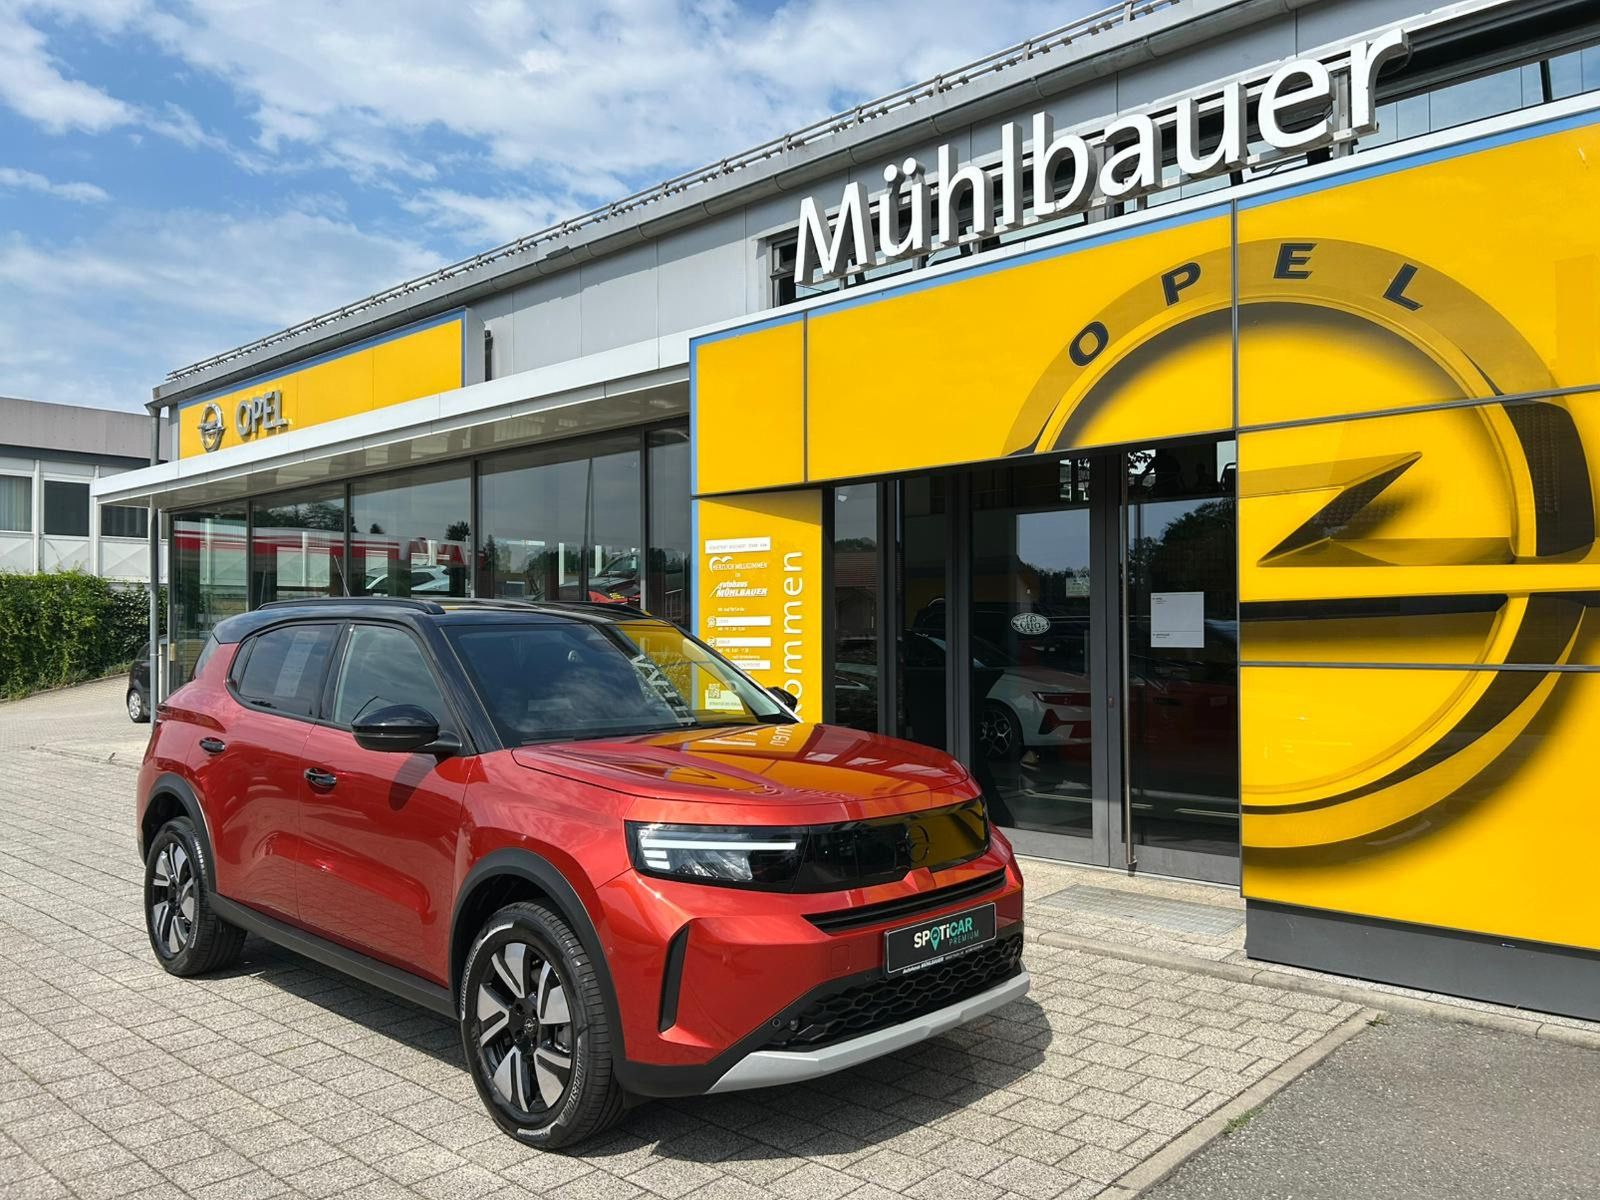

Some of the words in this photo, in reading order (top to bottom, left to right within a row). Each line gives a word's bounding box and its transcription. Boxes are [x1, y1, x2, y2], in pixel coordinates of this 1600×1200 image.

[794, 28, 1411, 286] Mühlbauer
[1068, 242, 1423, 367] OPEL
[236, 390, 289, 437] OPEL
[784, 551, 803, 713] ommen
[948, 929, 979, 946] PREMIUM
